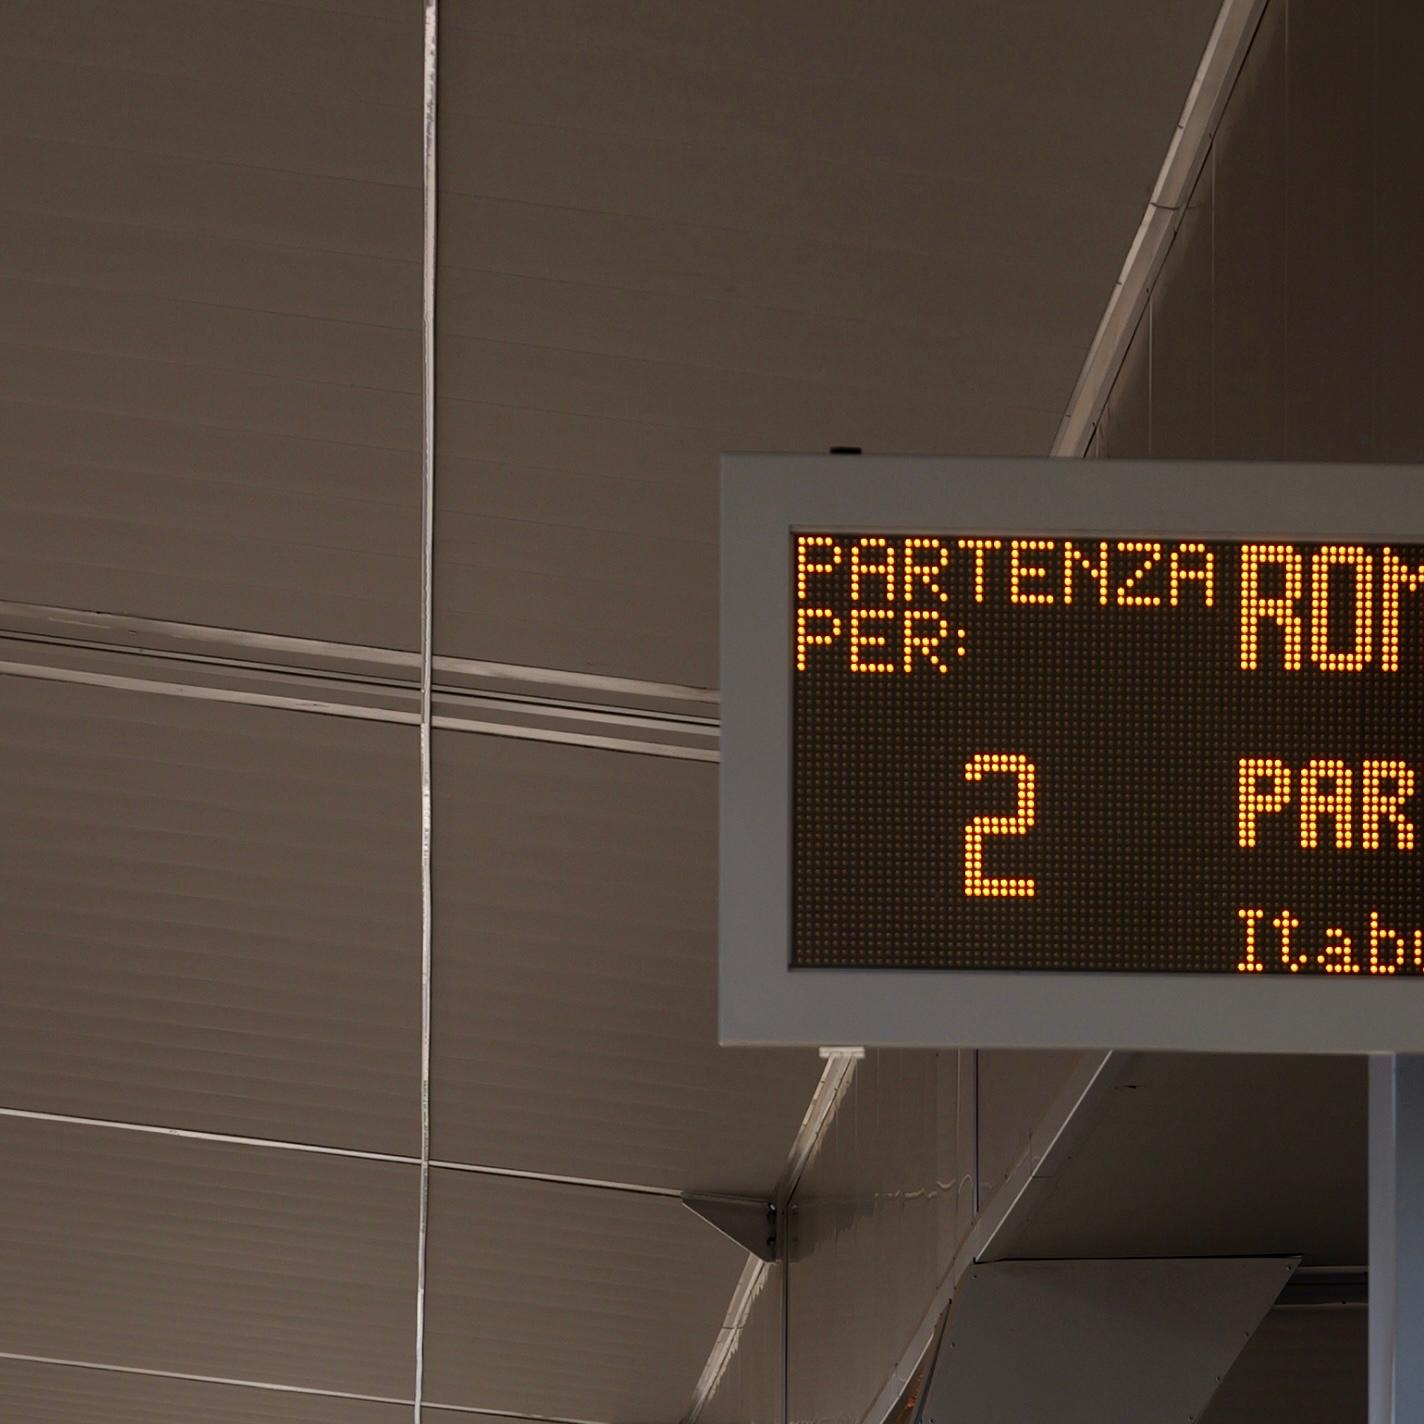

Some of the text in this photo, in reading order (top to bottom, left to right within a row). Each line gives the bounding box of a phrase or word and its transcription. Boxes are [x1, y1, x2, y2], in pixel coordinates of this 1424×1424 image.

[797, 536, 1214, 606] PARTENZA
[797, 608, 966, 673] PER:
[964, 754, 1035, 897] 2
